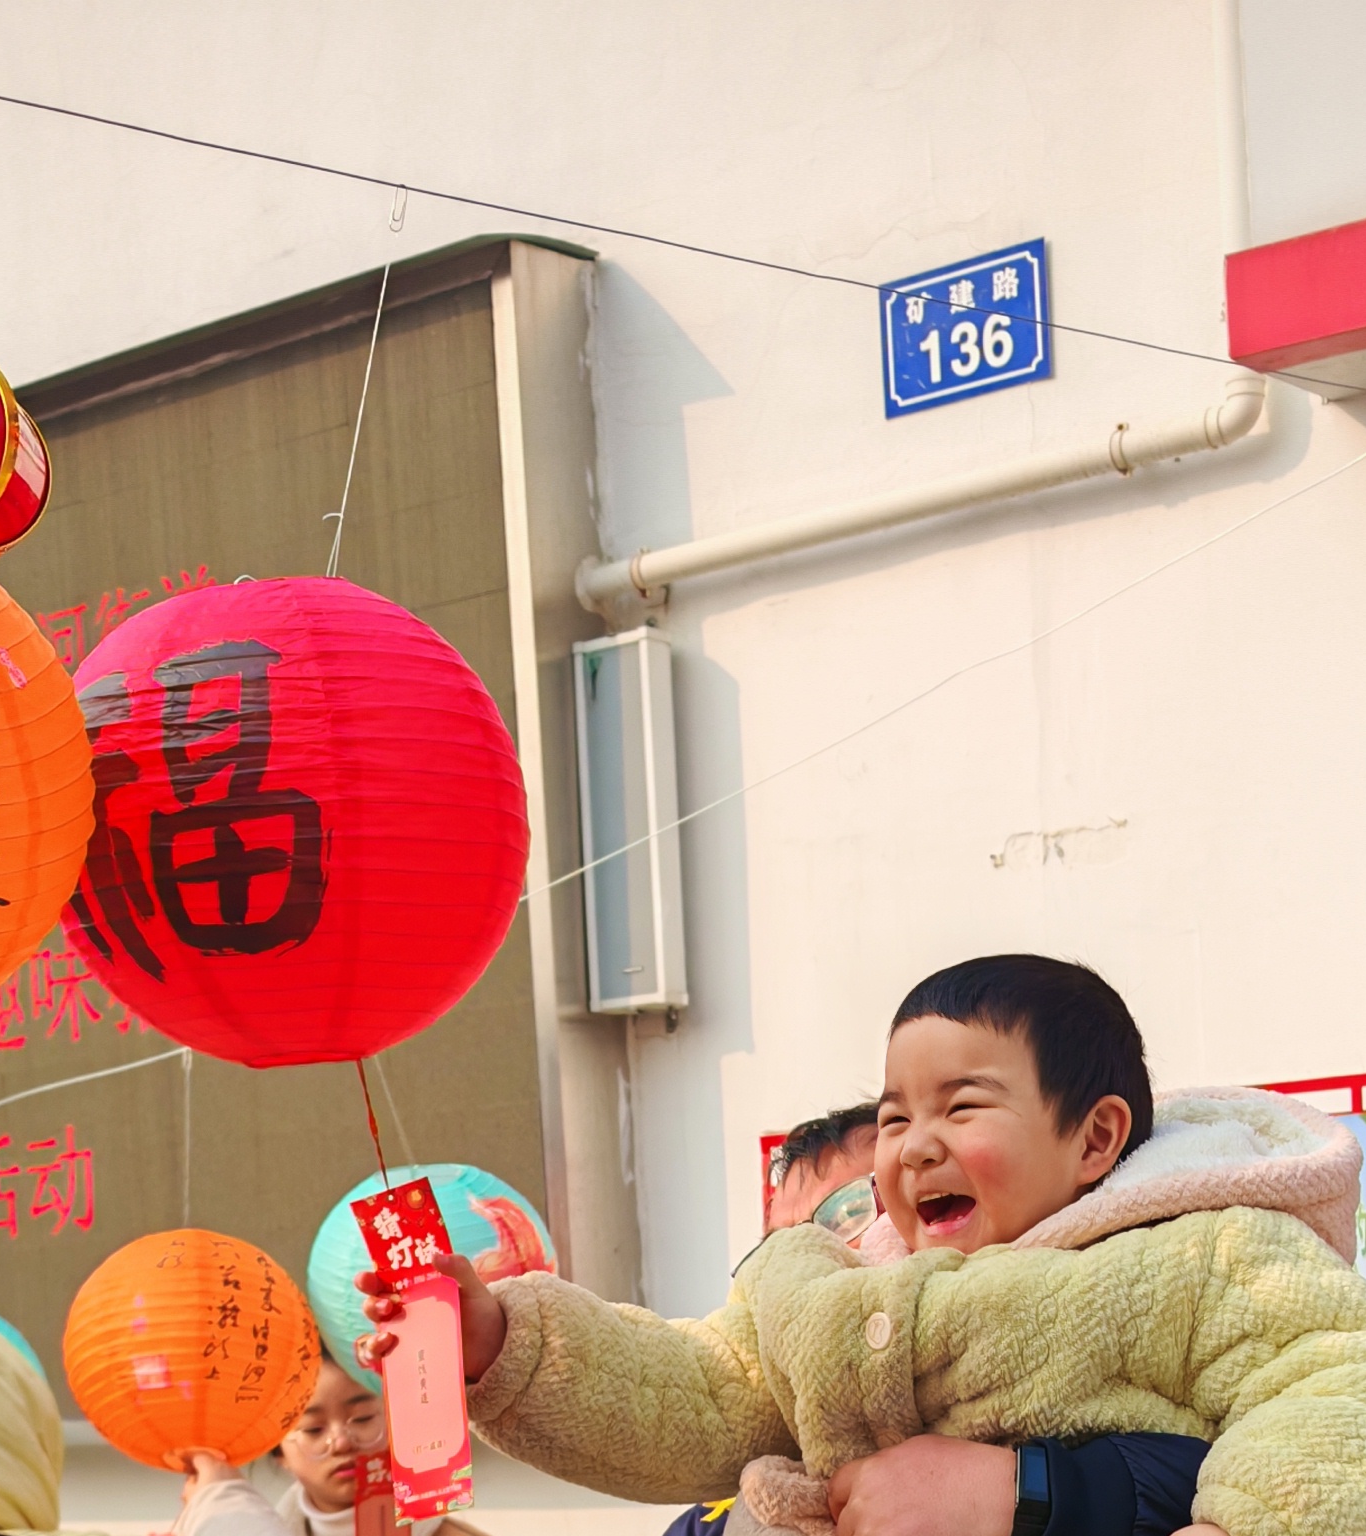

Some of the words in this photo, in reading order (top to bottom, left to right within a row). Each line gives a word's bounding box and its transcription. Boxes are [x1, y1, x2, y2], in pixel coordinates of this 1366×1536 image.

[905, 266, 1020, 325] 矿建路
[919, 313, 1014, 384] 136
